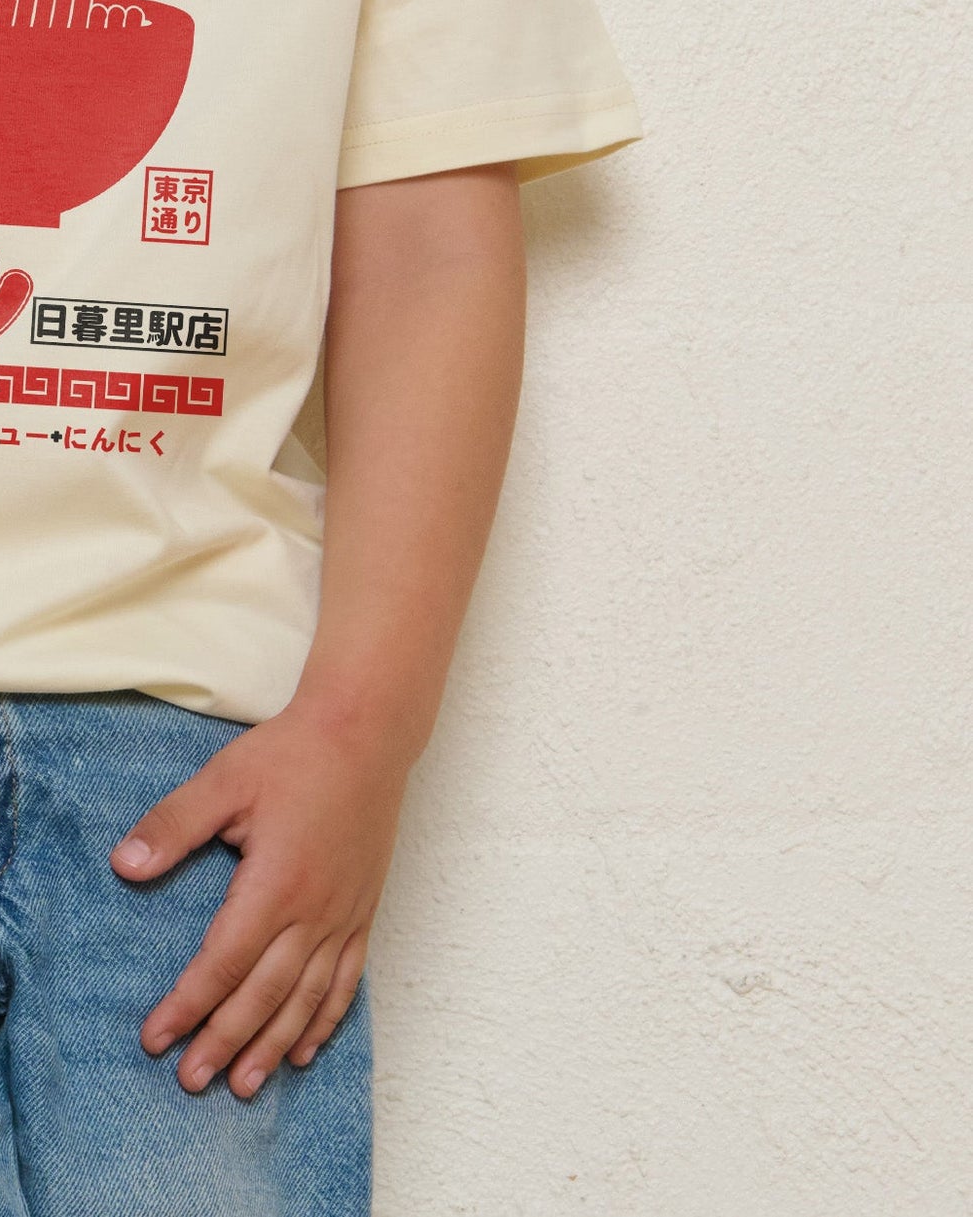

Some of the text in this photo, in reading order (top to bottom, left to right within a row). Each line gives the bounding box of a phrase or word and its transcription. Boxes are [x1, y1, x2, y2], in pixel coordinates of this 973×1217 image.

[153, 175, 208, 204] 東京
[150, 206, 202, 234] 通り
[36, 303, 222, 350] 日暮里駅店
